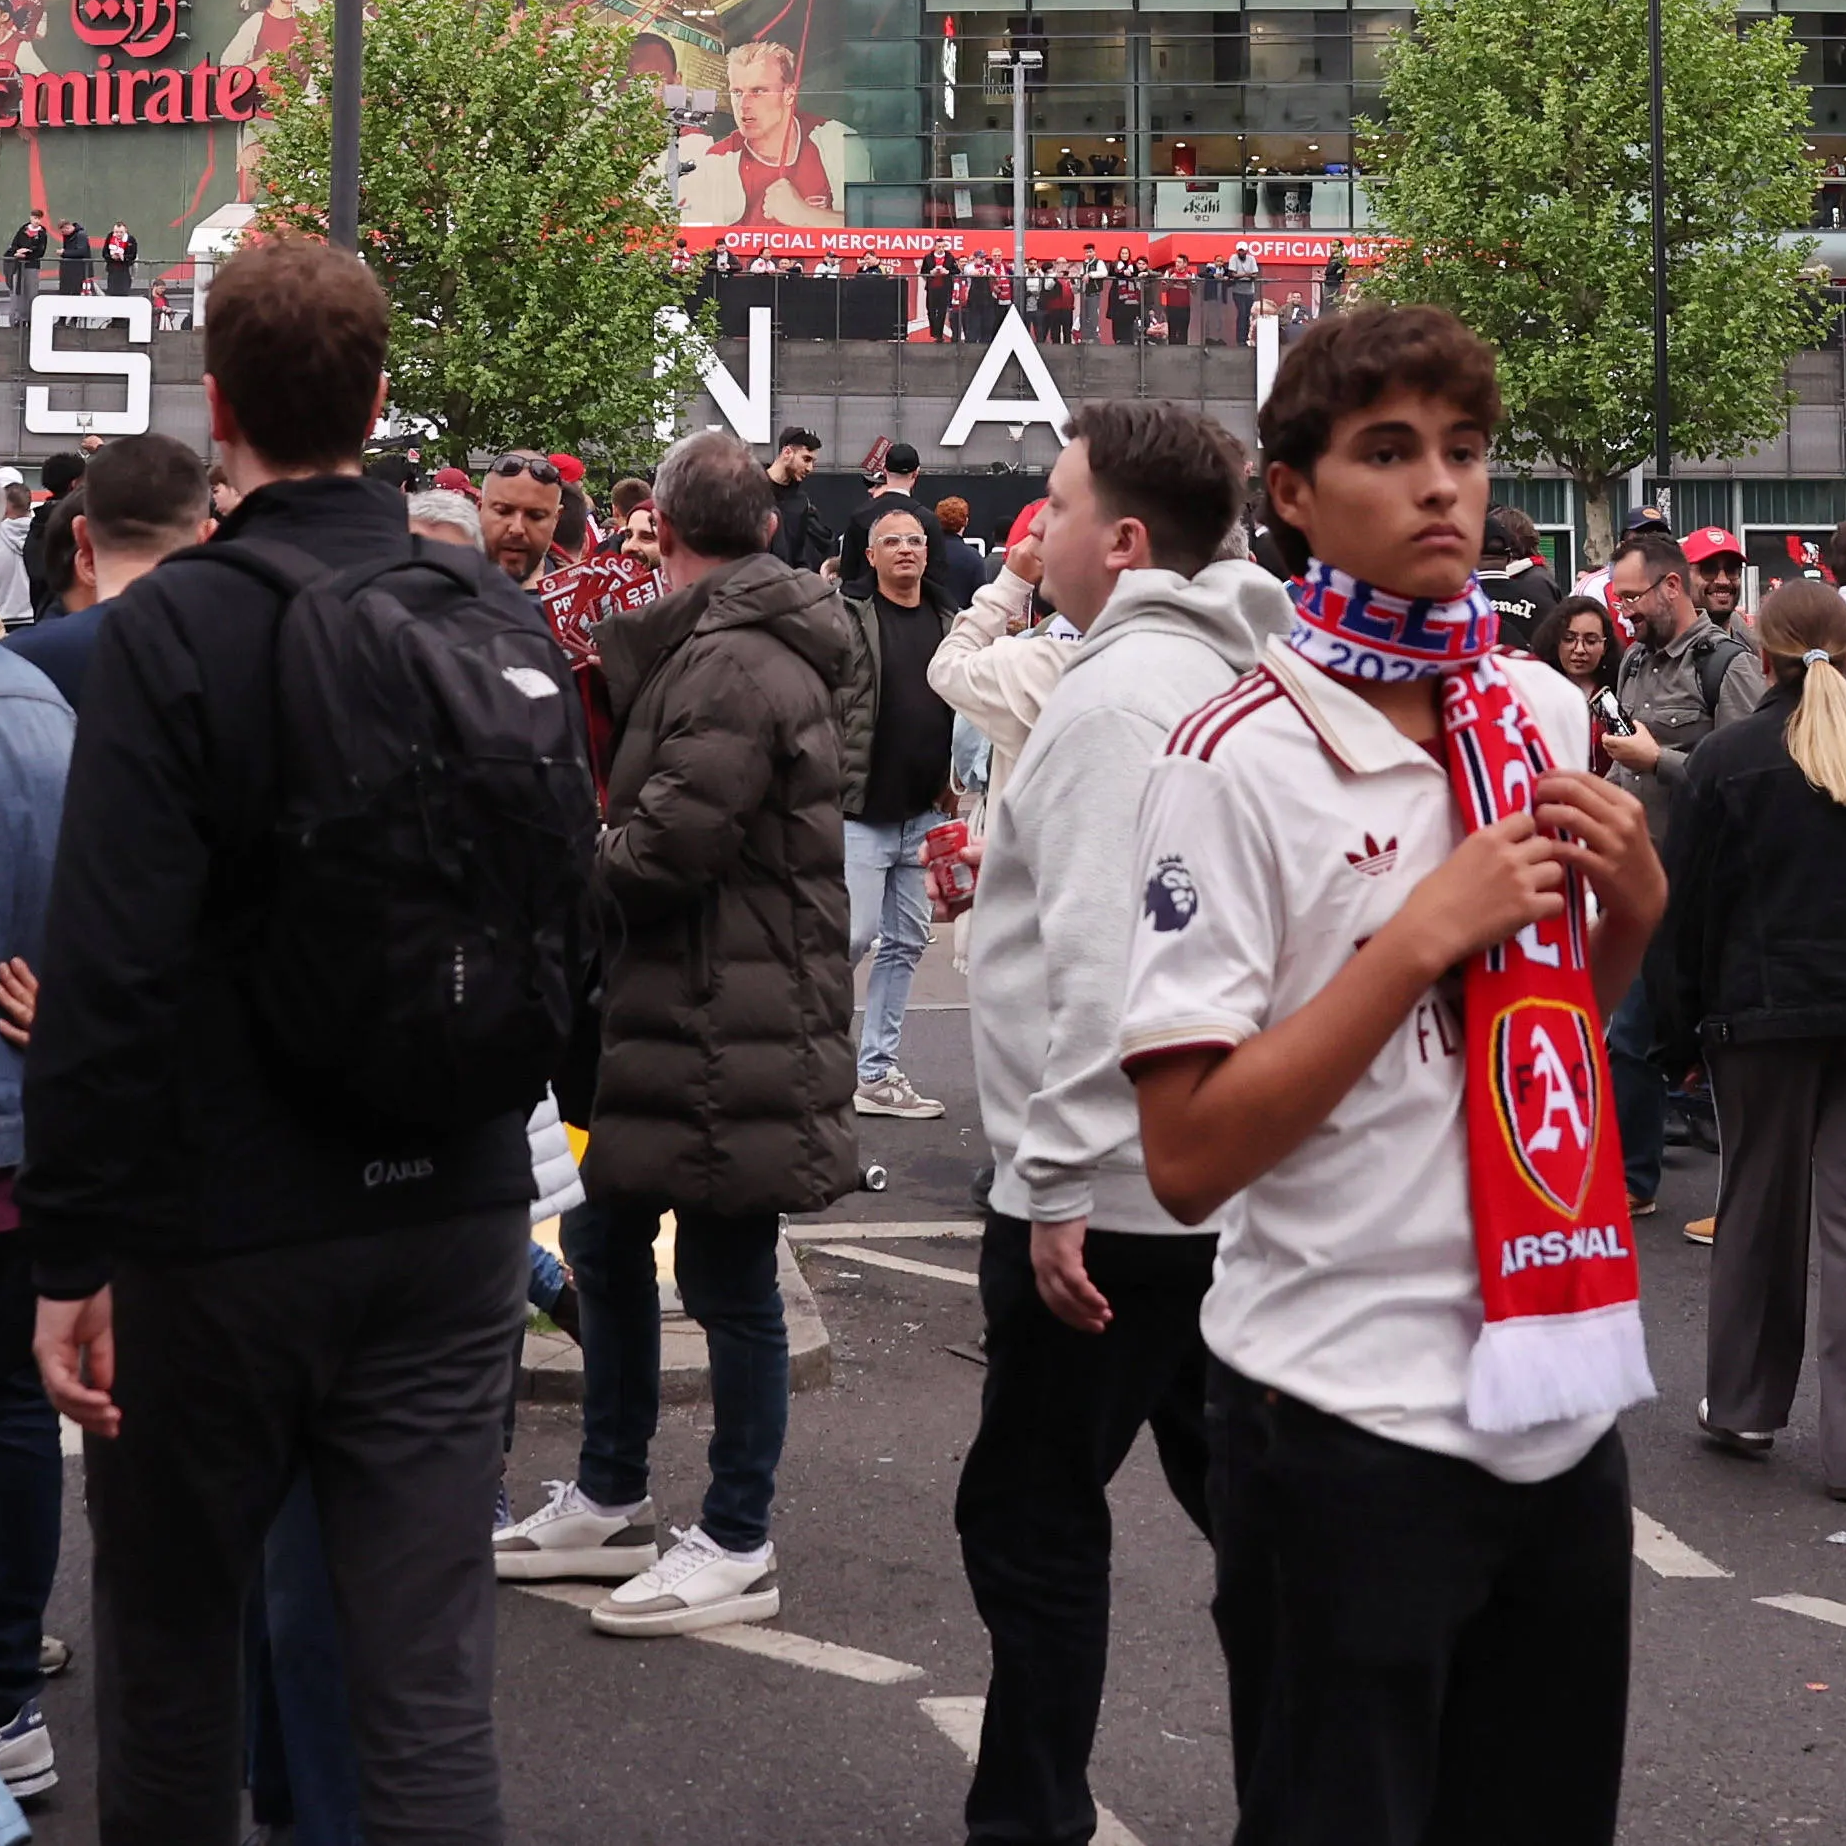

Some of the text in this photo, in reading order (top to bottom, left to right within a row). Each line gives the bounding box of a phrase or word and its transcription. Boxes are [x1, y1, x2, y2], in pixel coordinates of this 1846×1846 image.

[1183, 197, 1221, 215] Asahi
[724, 231, 815, 250] OFFICIAL
[1248, 240, 1330, 258] OFFICIAL
